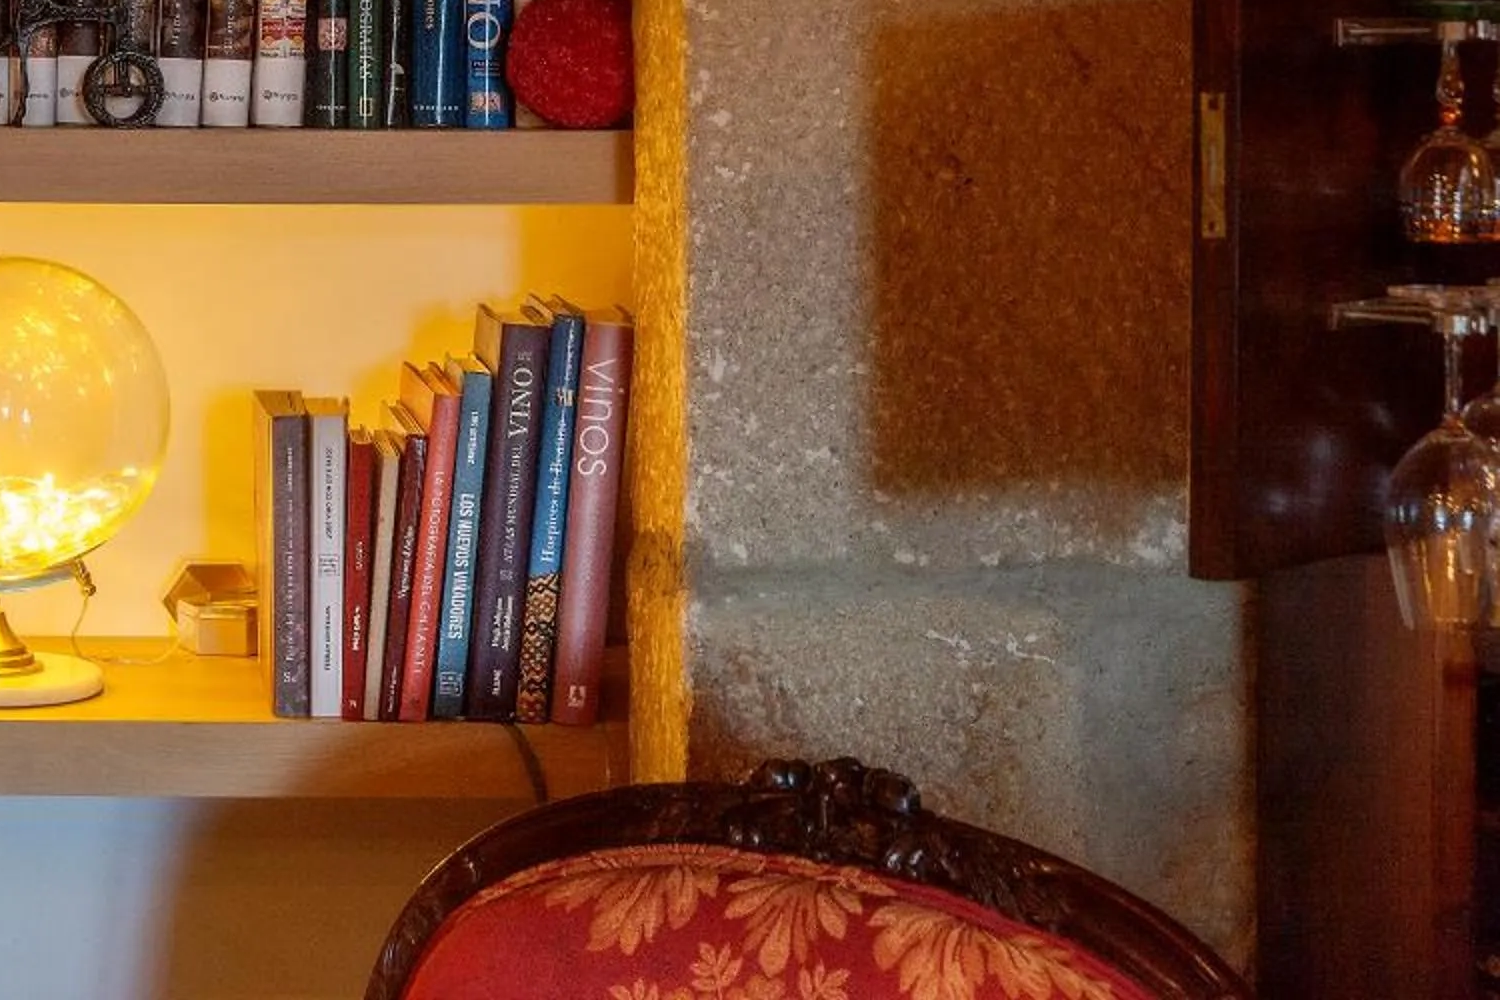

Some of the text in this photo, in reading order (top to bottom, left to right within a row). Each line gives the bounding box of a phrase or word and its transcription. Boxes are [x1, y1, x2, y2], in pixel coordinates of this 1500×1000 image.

[500, 365, 534, 563] ATLAS MUNDIAL DEL VINO
[577, 359, 625, 477] vinos
[421, 574, 433, 596] DEL
[445, 492, 475, 640] LOS NUEVOS VIÑADORES
